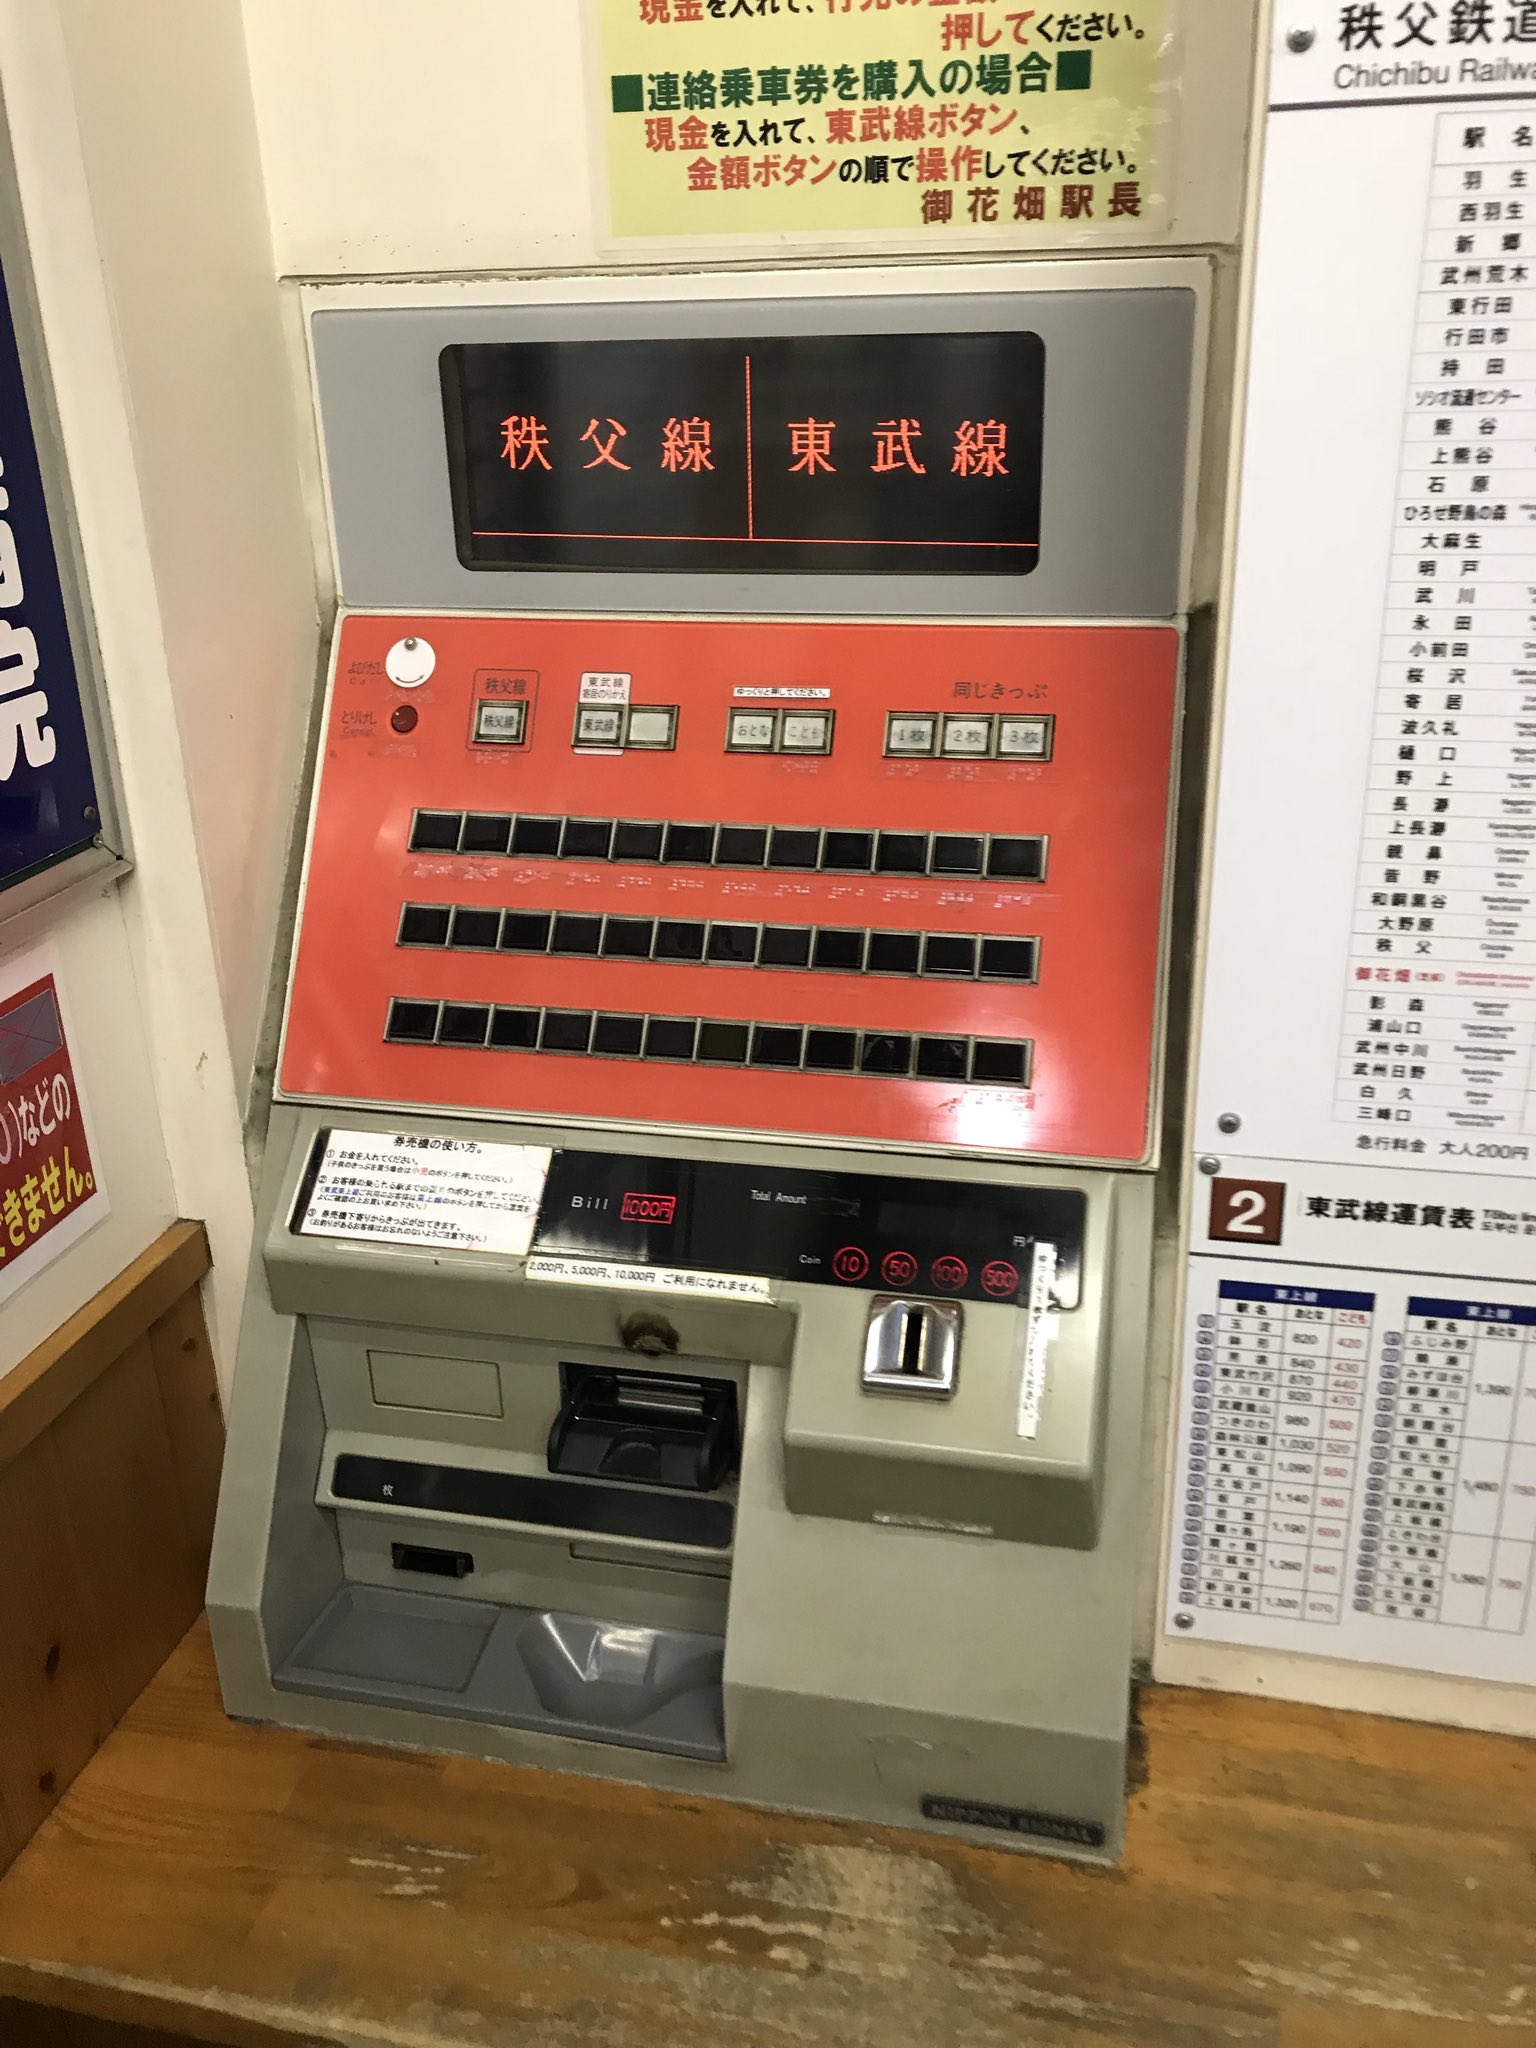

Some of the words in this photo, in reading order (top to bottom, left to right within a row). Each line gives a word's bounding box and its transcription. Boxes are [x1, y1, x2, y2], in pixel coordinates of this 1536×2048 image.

[941, 11, 1145, 51] 押してください。
[647, 52, 1052, 112] 連絡乗車券を購入の場合
[1333, 61, 1450, 89] Chichibu
[643, 103, 1031, 153] 現金を入れて、東武線ボタン、
[686, 145, 1139, 192] 金額ボタンの順で操作してください。
[920, 182, 1142, 225] 御花畑駅長
[499, 414, 716, 472] 秩父線
[786, 417, 1010, 478] 東武線
[485, 677, 527, 695] 秩父線
[953, 681, 1049, 700] 同じきっぷ
[735, 723, 771, 738] おとな
[787, 725, 822, 739] こども
[898, 727, 925, 744] 1枚
[952, 729, 982, 745] 2枚
[1009, 729, 1039, 745] 3枚
[1439, 1140, 1529, 1160] 大人200円
[0, 1147, 93, 1246] きません。
[571, 1195, 609, 1210] Bill
[751, 1189, 772, 1202] Total
[775, 1192, 808, 1205] Amount
[623, 1198, 672, 1219] 1000円
[1225, 1189, 1267, 1235] 2
[1305, 1196, 1475, 1231] 東武線運賃表
[800, 1254, 822, 1266] Coin
[840, 1255, 860, 1273] 10
[889, 1259, 911, 1279] 50
[529, 1260, 656, 1284] 2,000円、5,000円、10,000円
[662, 1273, 767, 1295] ご利用になれません。
[938, 1264, 962, 1283] 100
[984, 1268, 1013, 1287] 500
[382, 1483, 394, 1497] 枚
